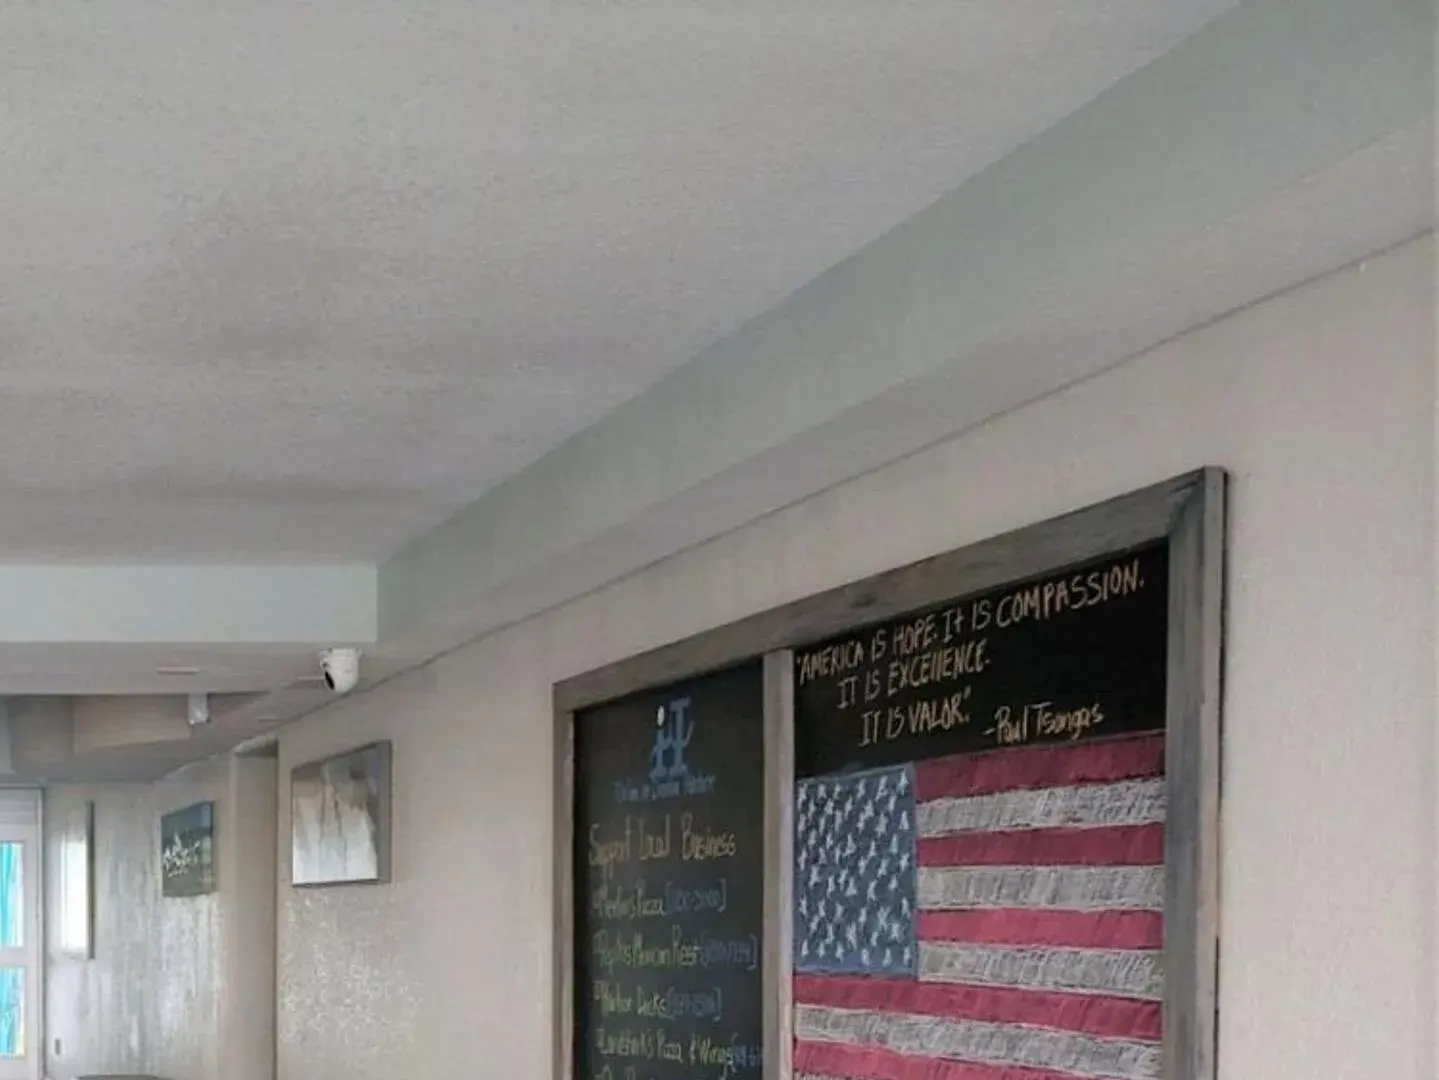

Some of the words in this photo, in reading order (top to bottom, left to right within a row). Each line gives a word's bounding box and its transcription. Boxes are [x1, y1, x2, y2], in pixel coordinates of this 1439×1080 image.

[871, 629, 887, 662] IS
[972, 600, 991, 631] IS
[996, 558, 1145, 629] COMPASSION.
[837, 675, 859, 709] IT
[865, 669, 882, 703] IS
[858, 709, 883, 748] IT
[886, 706, 905, 740] IS
